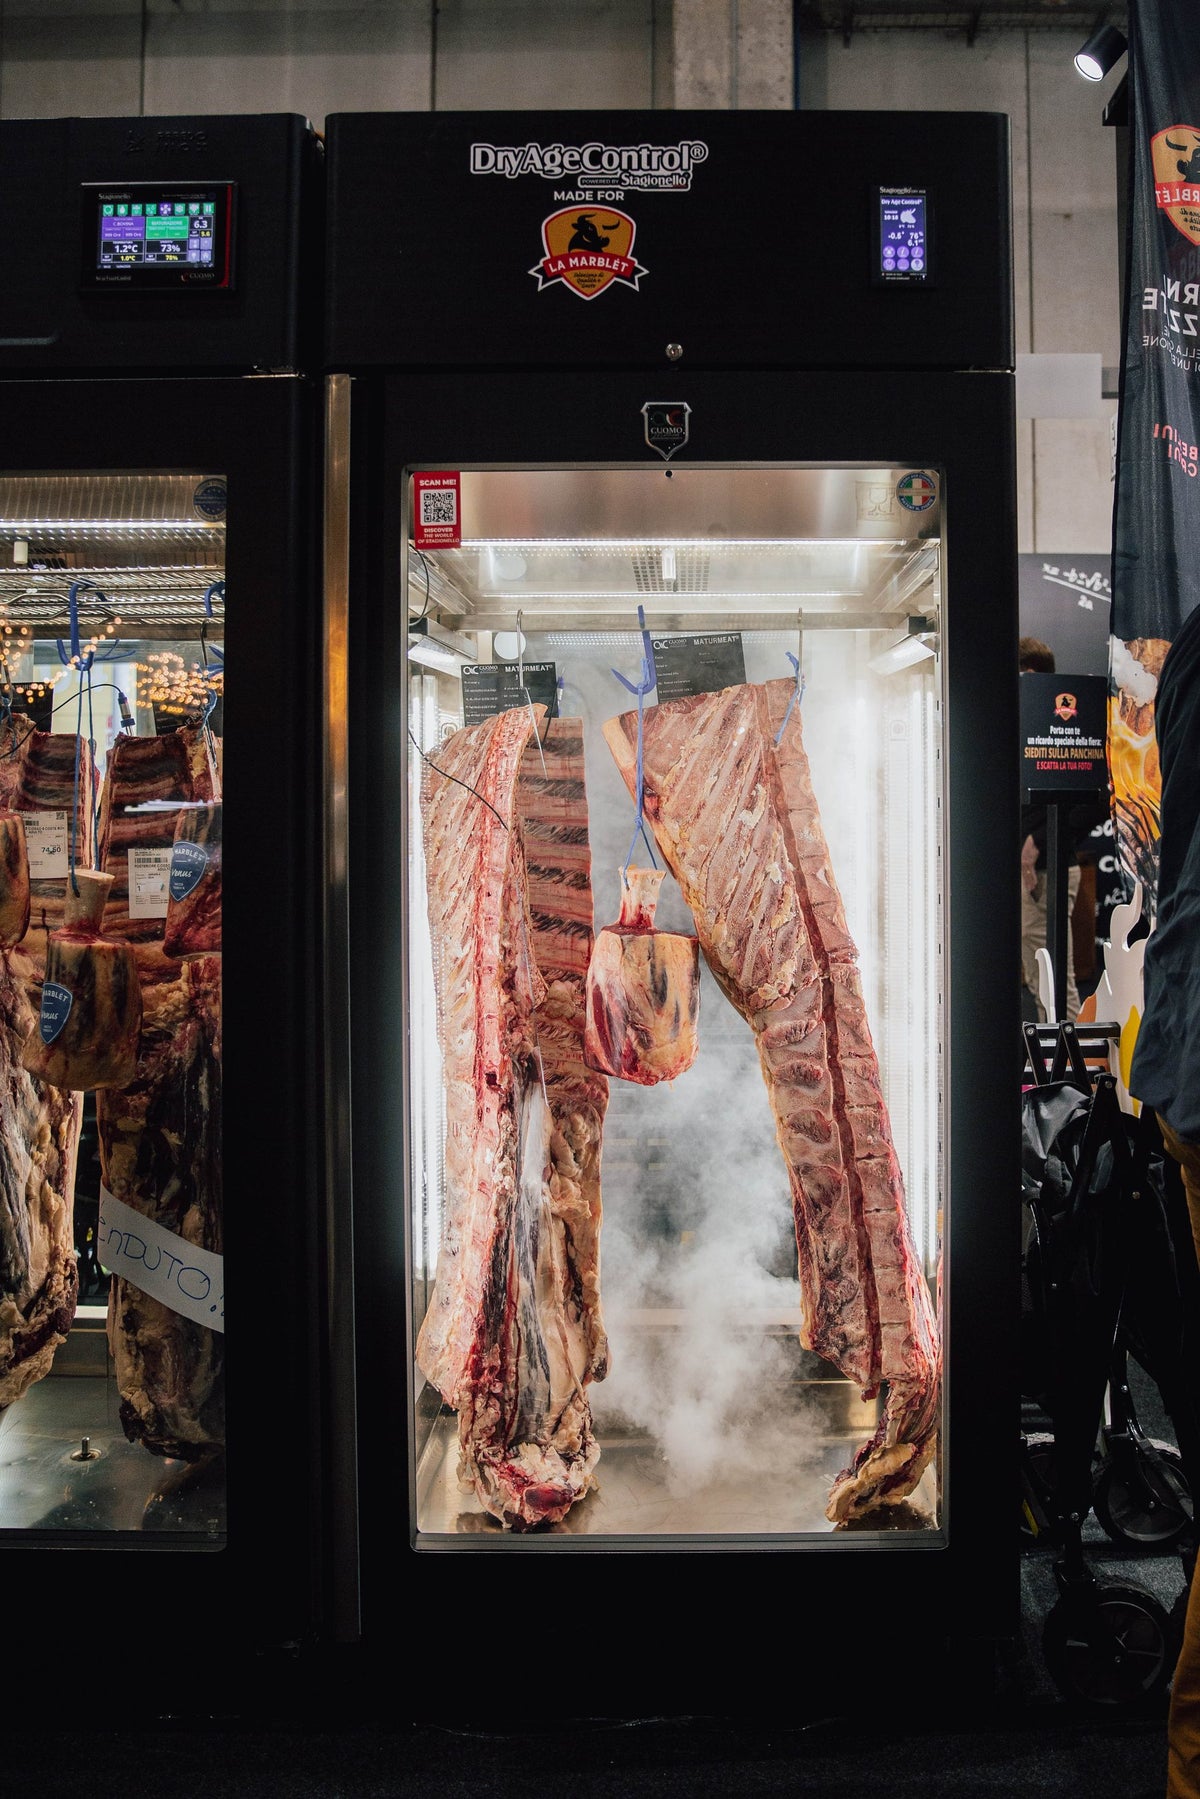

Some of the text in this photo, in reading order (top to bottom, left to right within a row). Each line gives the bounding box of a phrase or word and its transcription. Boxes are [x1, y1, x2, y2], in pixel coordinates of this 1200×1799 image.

[554, 191, 625, 201] MADE FOR
[194, 220, 208, 228] 6.3
[160, 244, 181, 253] 73%
[549, 256, 629, 273] LA MARBLÉT
[419, 479, 441, 487] SCAN
[1050, 725, 1064, 735] Porta
[1075, 727, 1081, 735] te
[1027, 737, 1035, 745] un
[1035, 735, 1054, 745] ricordo
[1054, 736, 1075, 747] speciale
[1075, 737, 1088, 745] della
[1024, 747, 1104, 759] SIEDITI SULLA PANCHINA
[1036, 761, 1040, 770] E
[1041, 761, 1059, 770] SCATTA
[1059, 761, 1066, 770] LA
[1067, 761, 1077, 770] TUA
